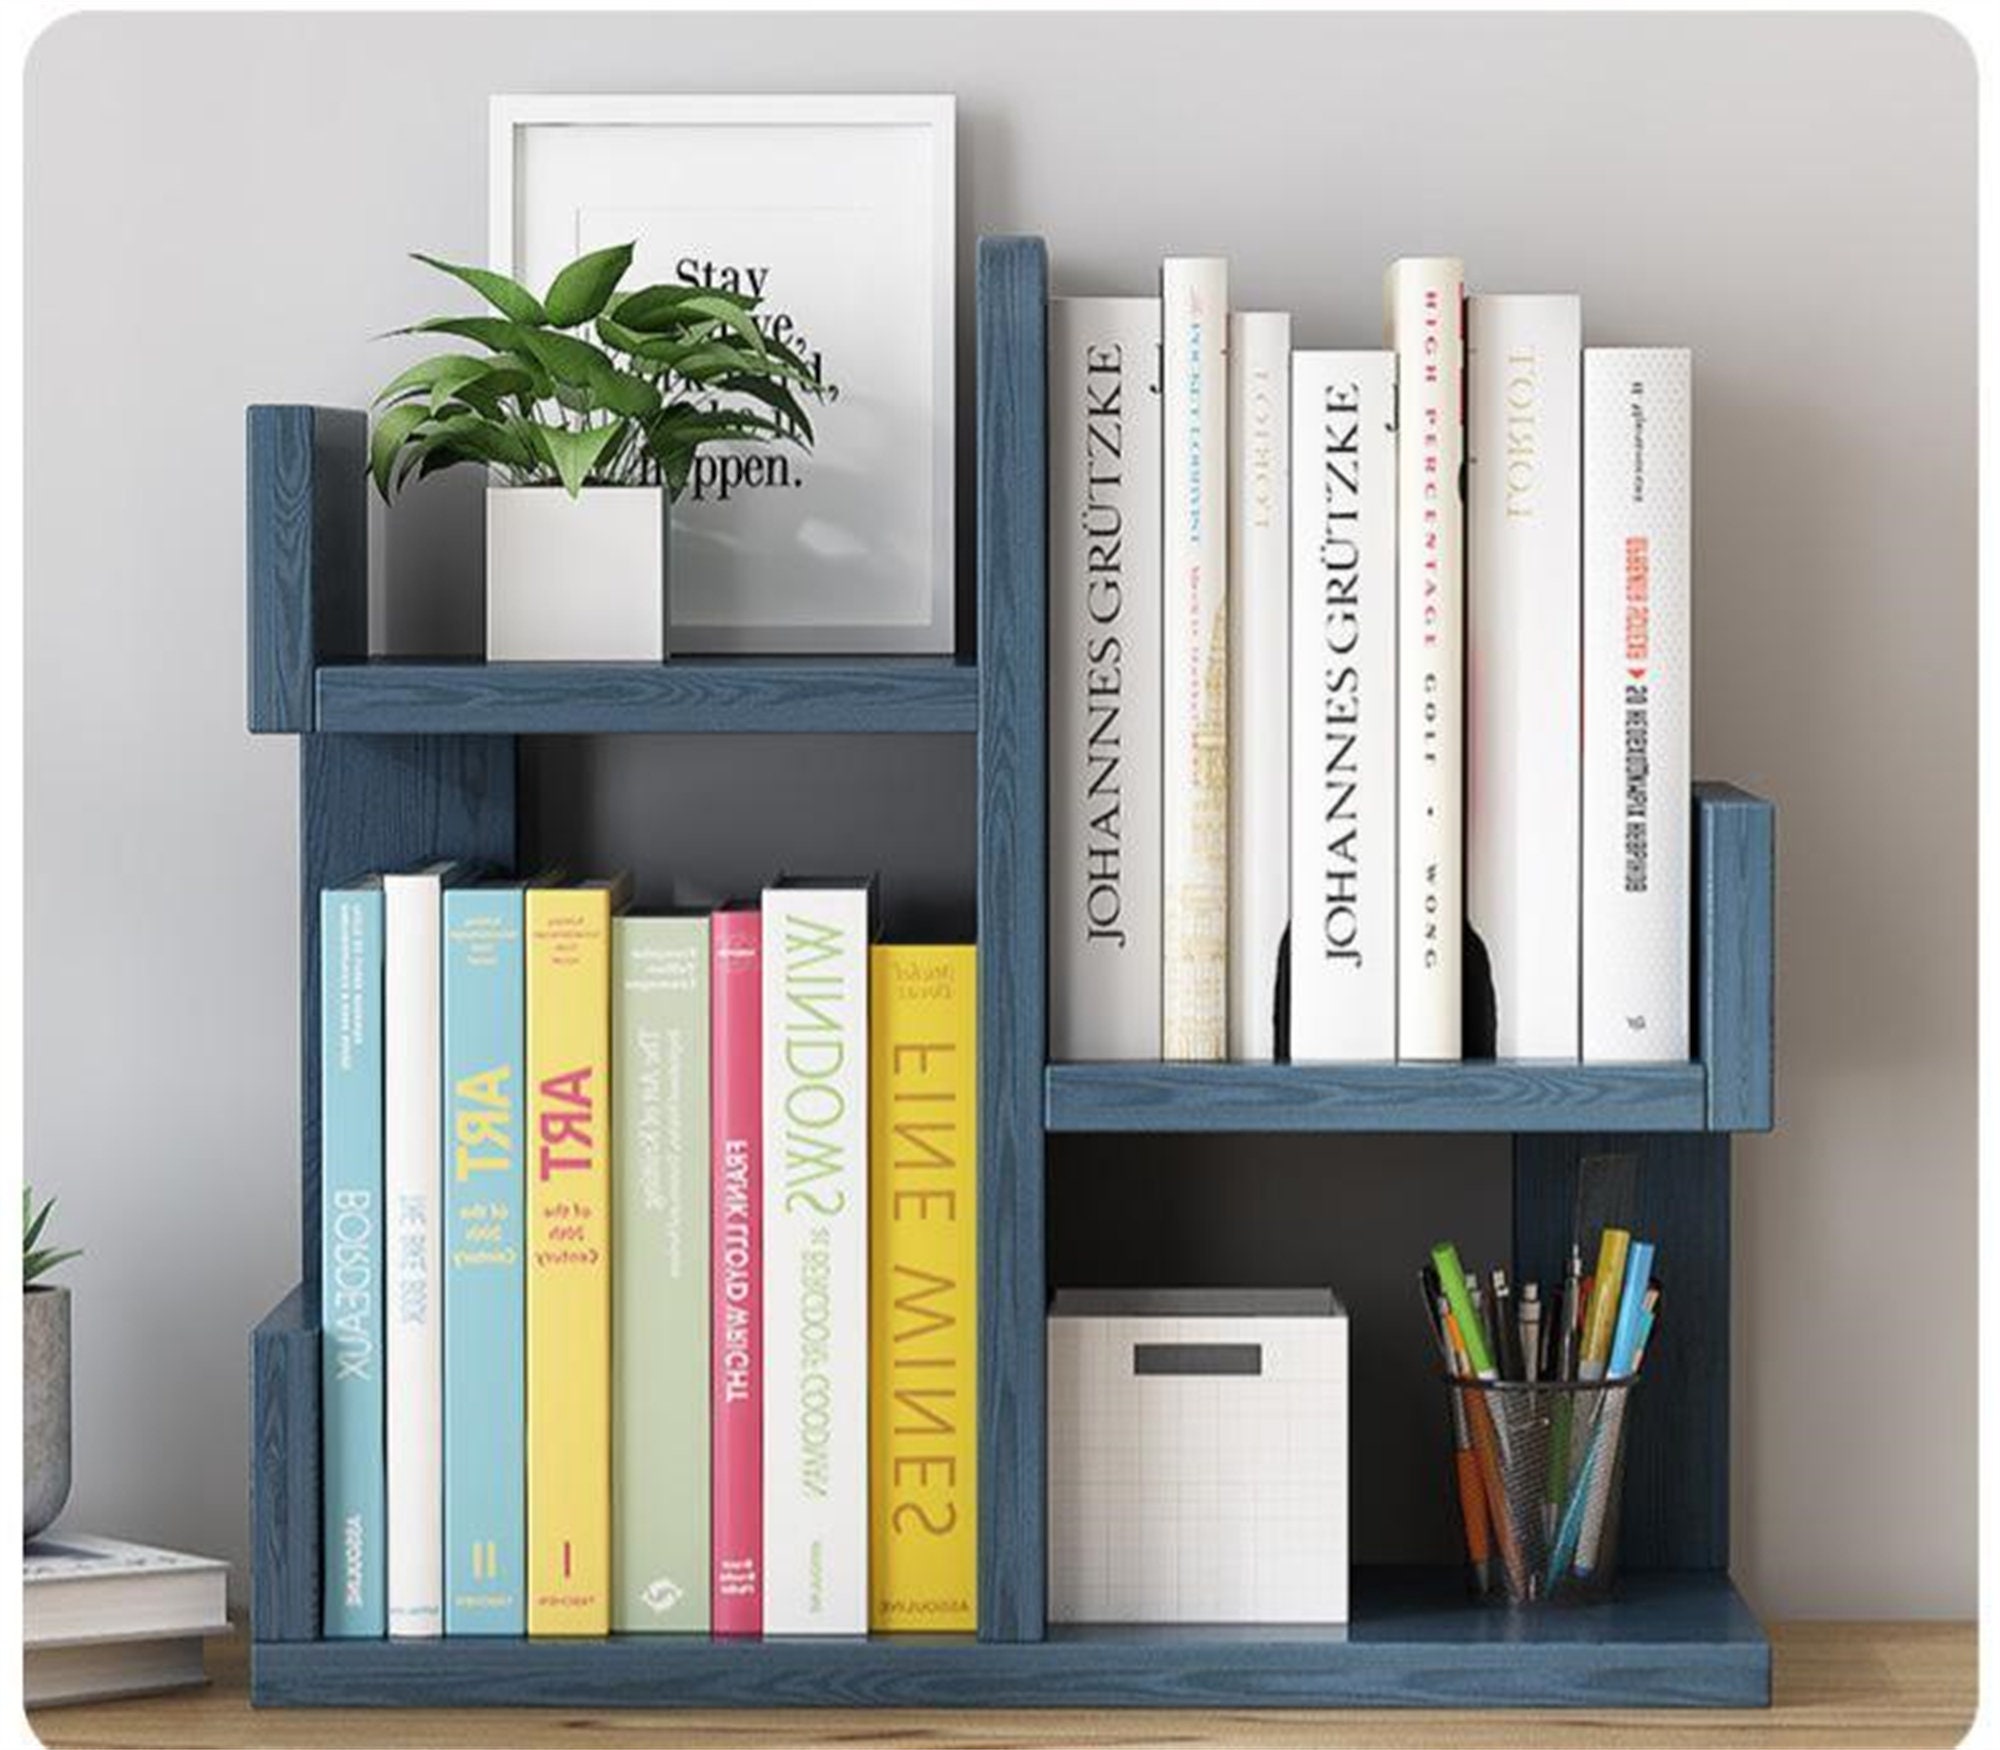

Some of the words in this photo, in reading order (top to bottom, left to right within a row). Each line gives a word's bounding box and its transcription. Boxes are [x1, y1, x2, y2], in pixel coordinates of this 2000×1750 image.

[675, 257, 770, 298] Stay
[1424, 290, 1439, 383] HIGH
[1081, 343, 1123, 624] GRÜTZKE
[1320, 383, 1360, 654] GRÜTZKE
[1424, 408, 1439, 646] PERCENTAGE
[1086, 640, 1126, 948] JOHANNES
[1324, 667, 1363, 968] JOHANNES
[1424, 673, 1438, 763] GOLF
[1424, 863, 1439, 970] WONG
